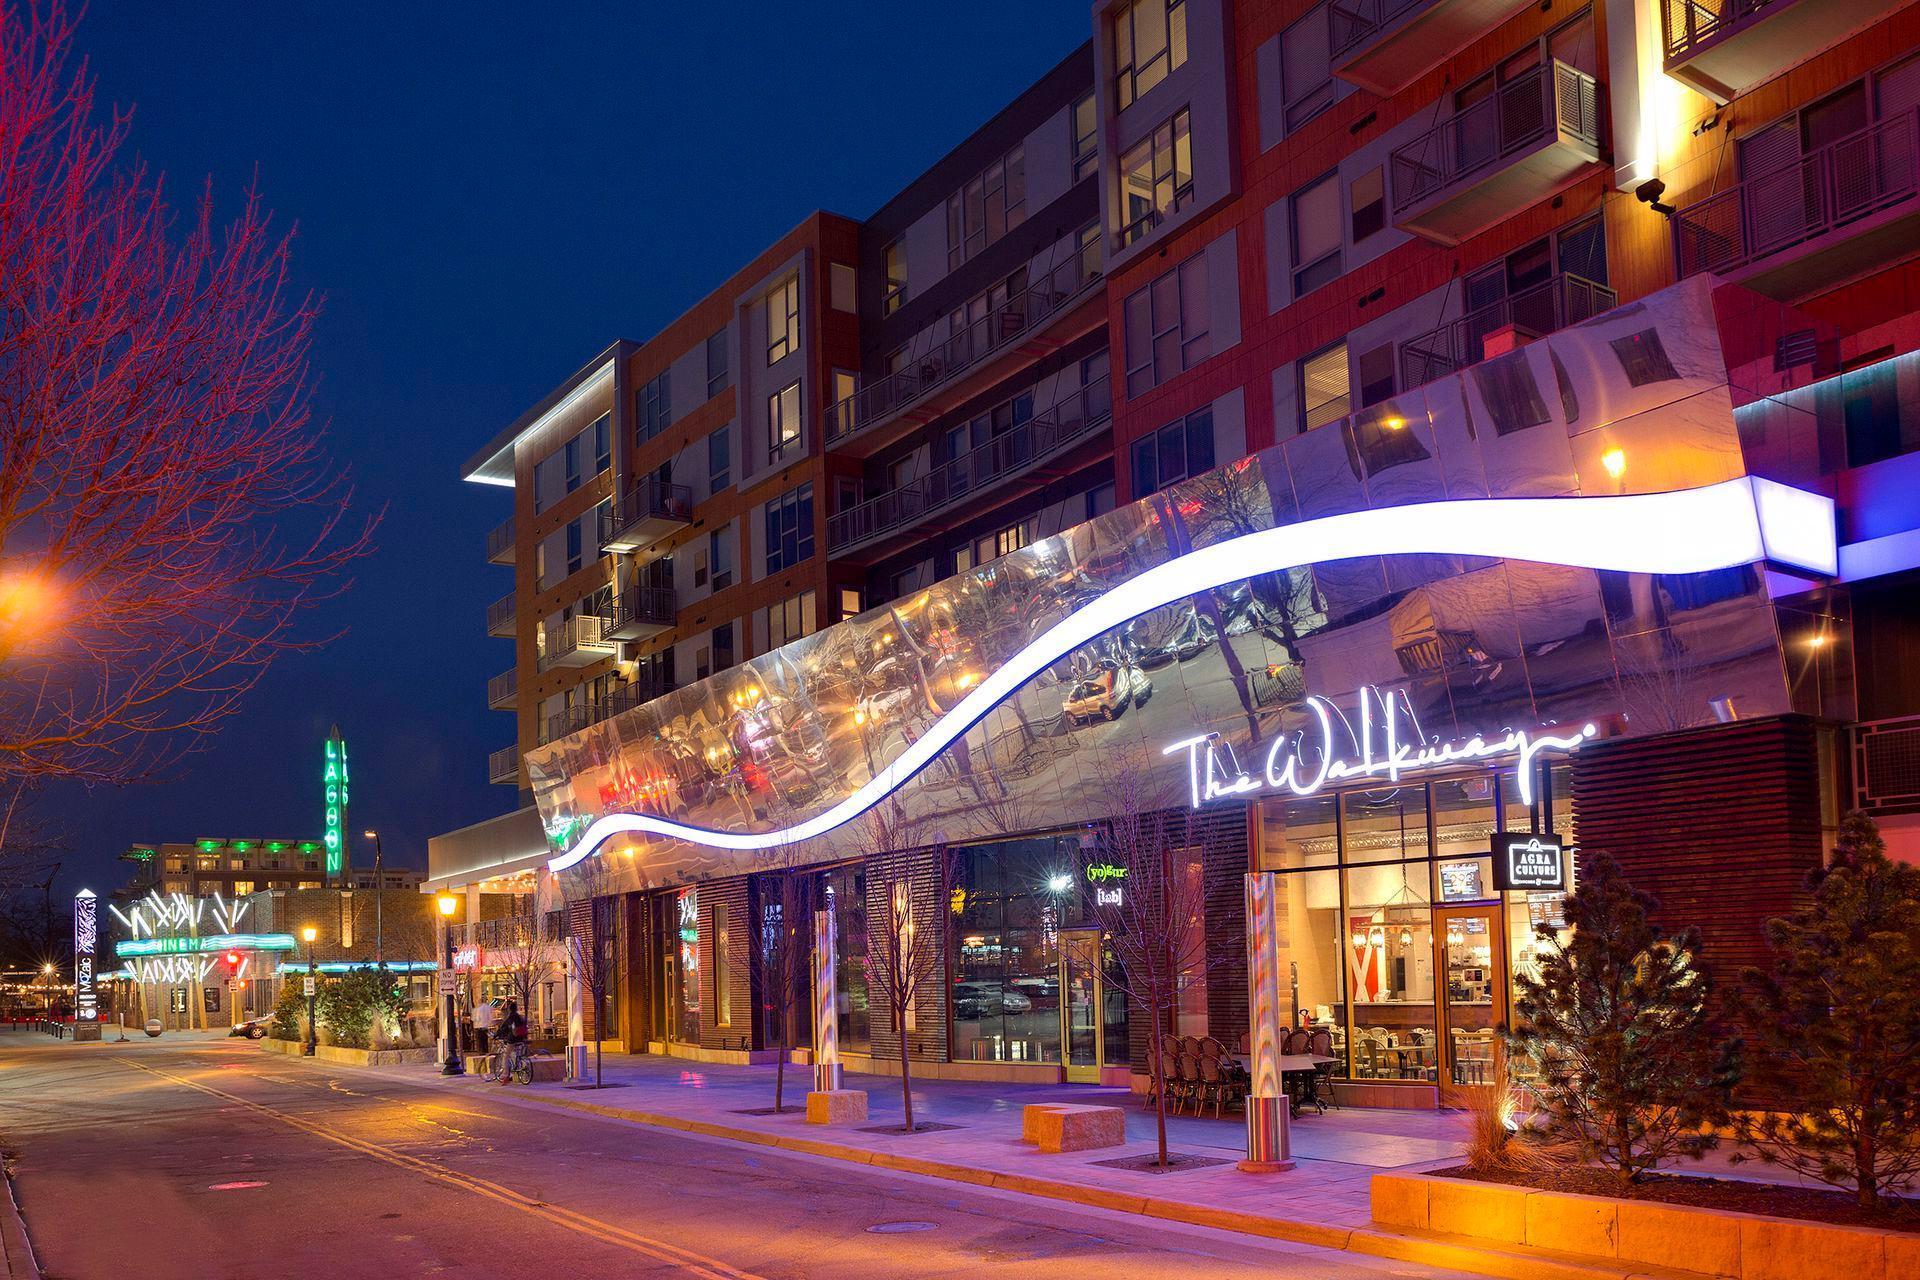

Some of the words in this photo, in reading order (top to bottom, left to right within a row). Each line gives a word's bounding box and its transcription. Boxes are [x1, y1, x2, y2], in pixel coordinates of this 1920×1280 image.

[1162, 732, 1263, 809] The
[1266, 685, 1598, 807] Walkway
[324, 740, 339, 872] LAGOON
[1515, 864, 1556, 876] CULTURE
[1520, 853, 1551, 865] AGRA
